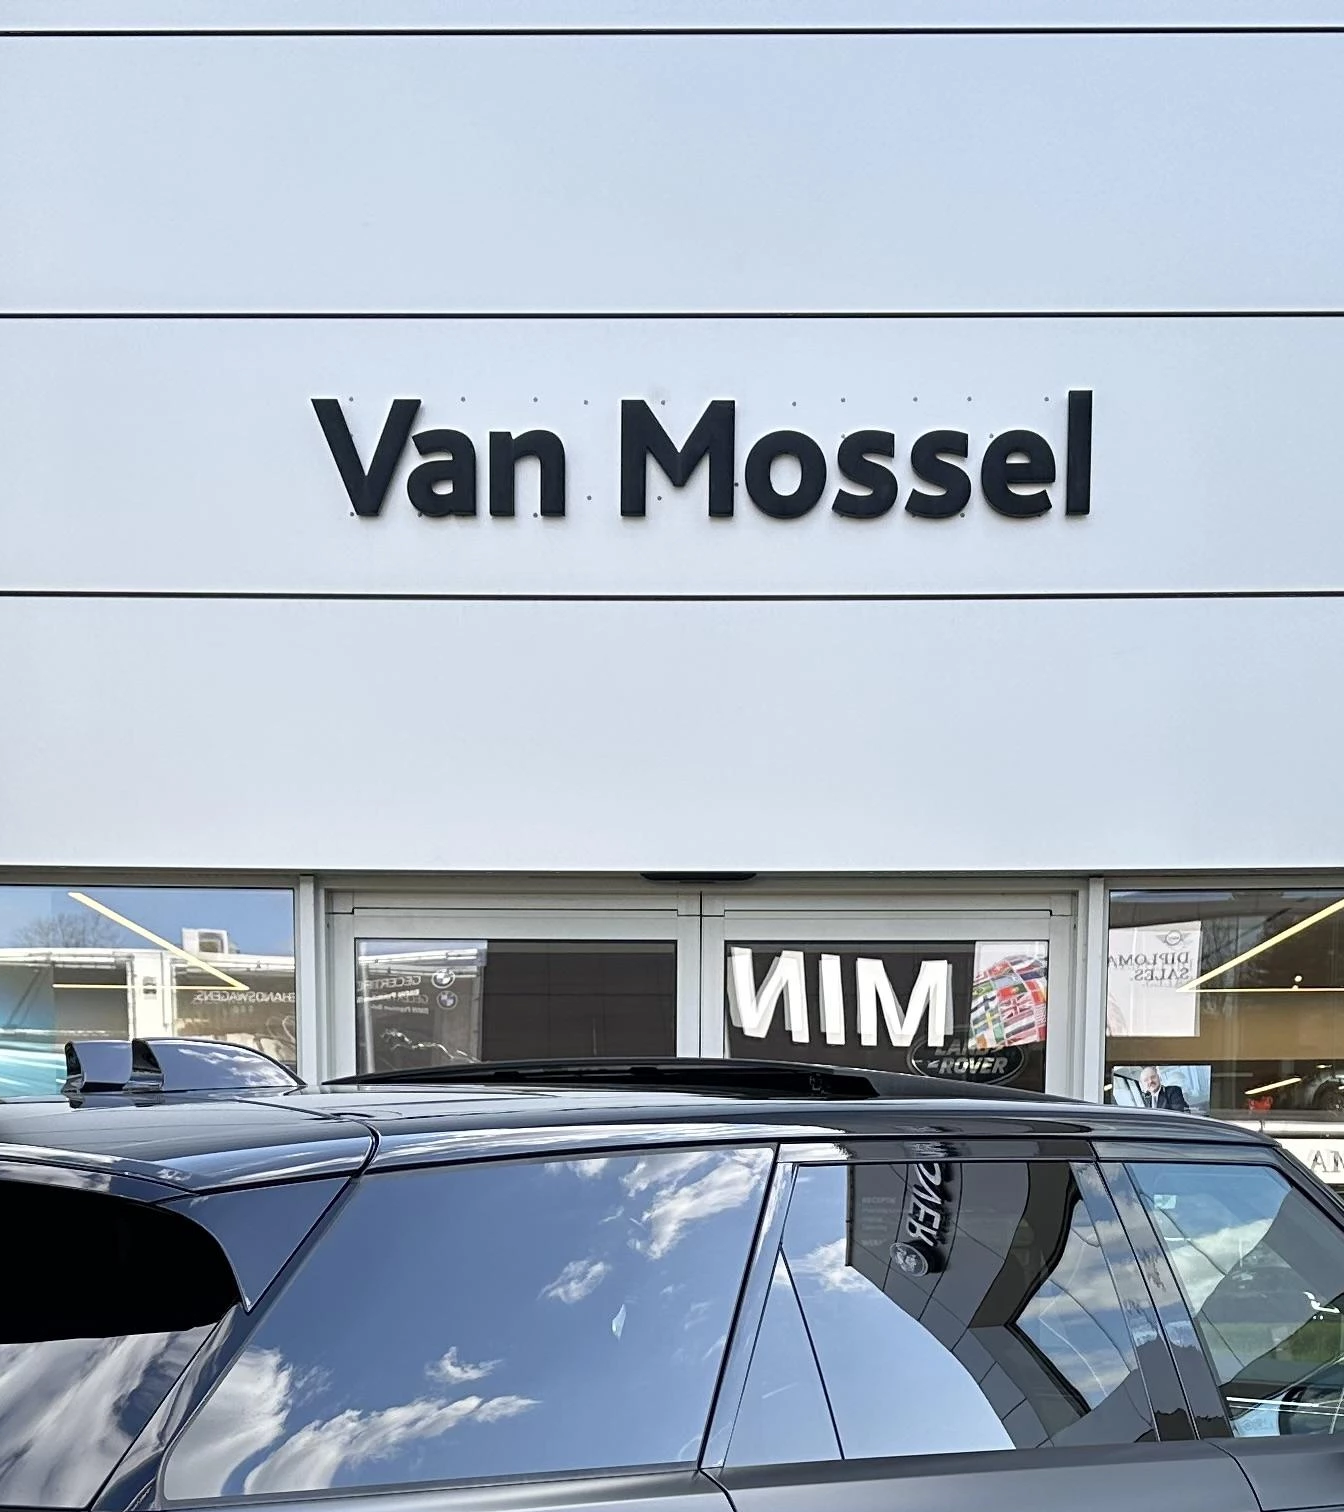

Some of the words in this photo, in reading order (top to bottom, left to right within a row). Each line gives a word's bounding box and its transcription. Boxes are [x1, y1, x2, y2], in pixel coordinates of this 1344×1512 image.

[310, 398, 566, 519] Van
[620, 388, 1094, 520] Mossel
[938, 1056, 1010, 1074] ROVER
